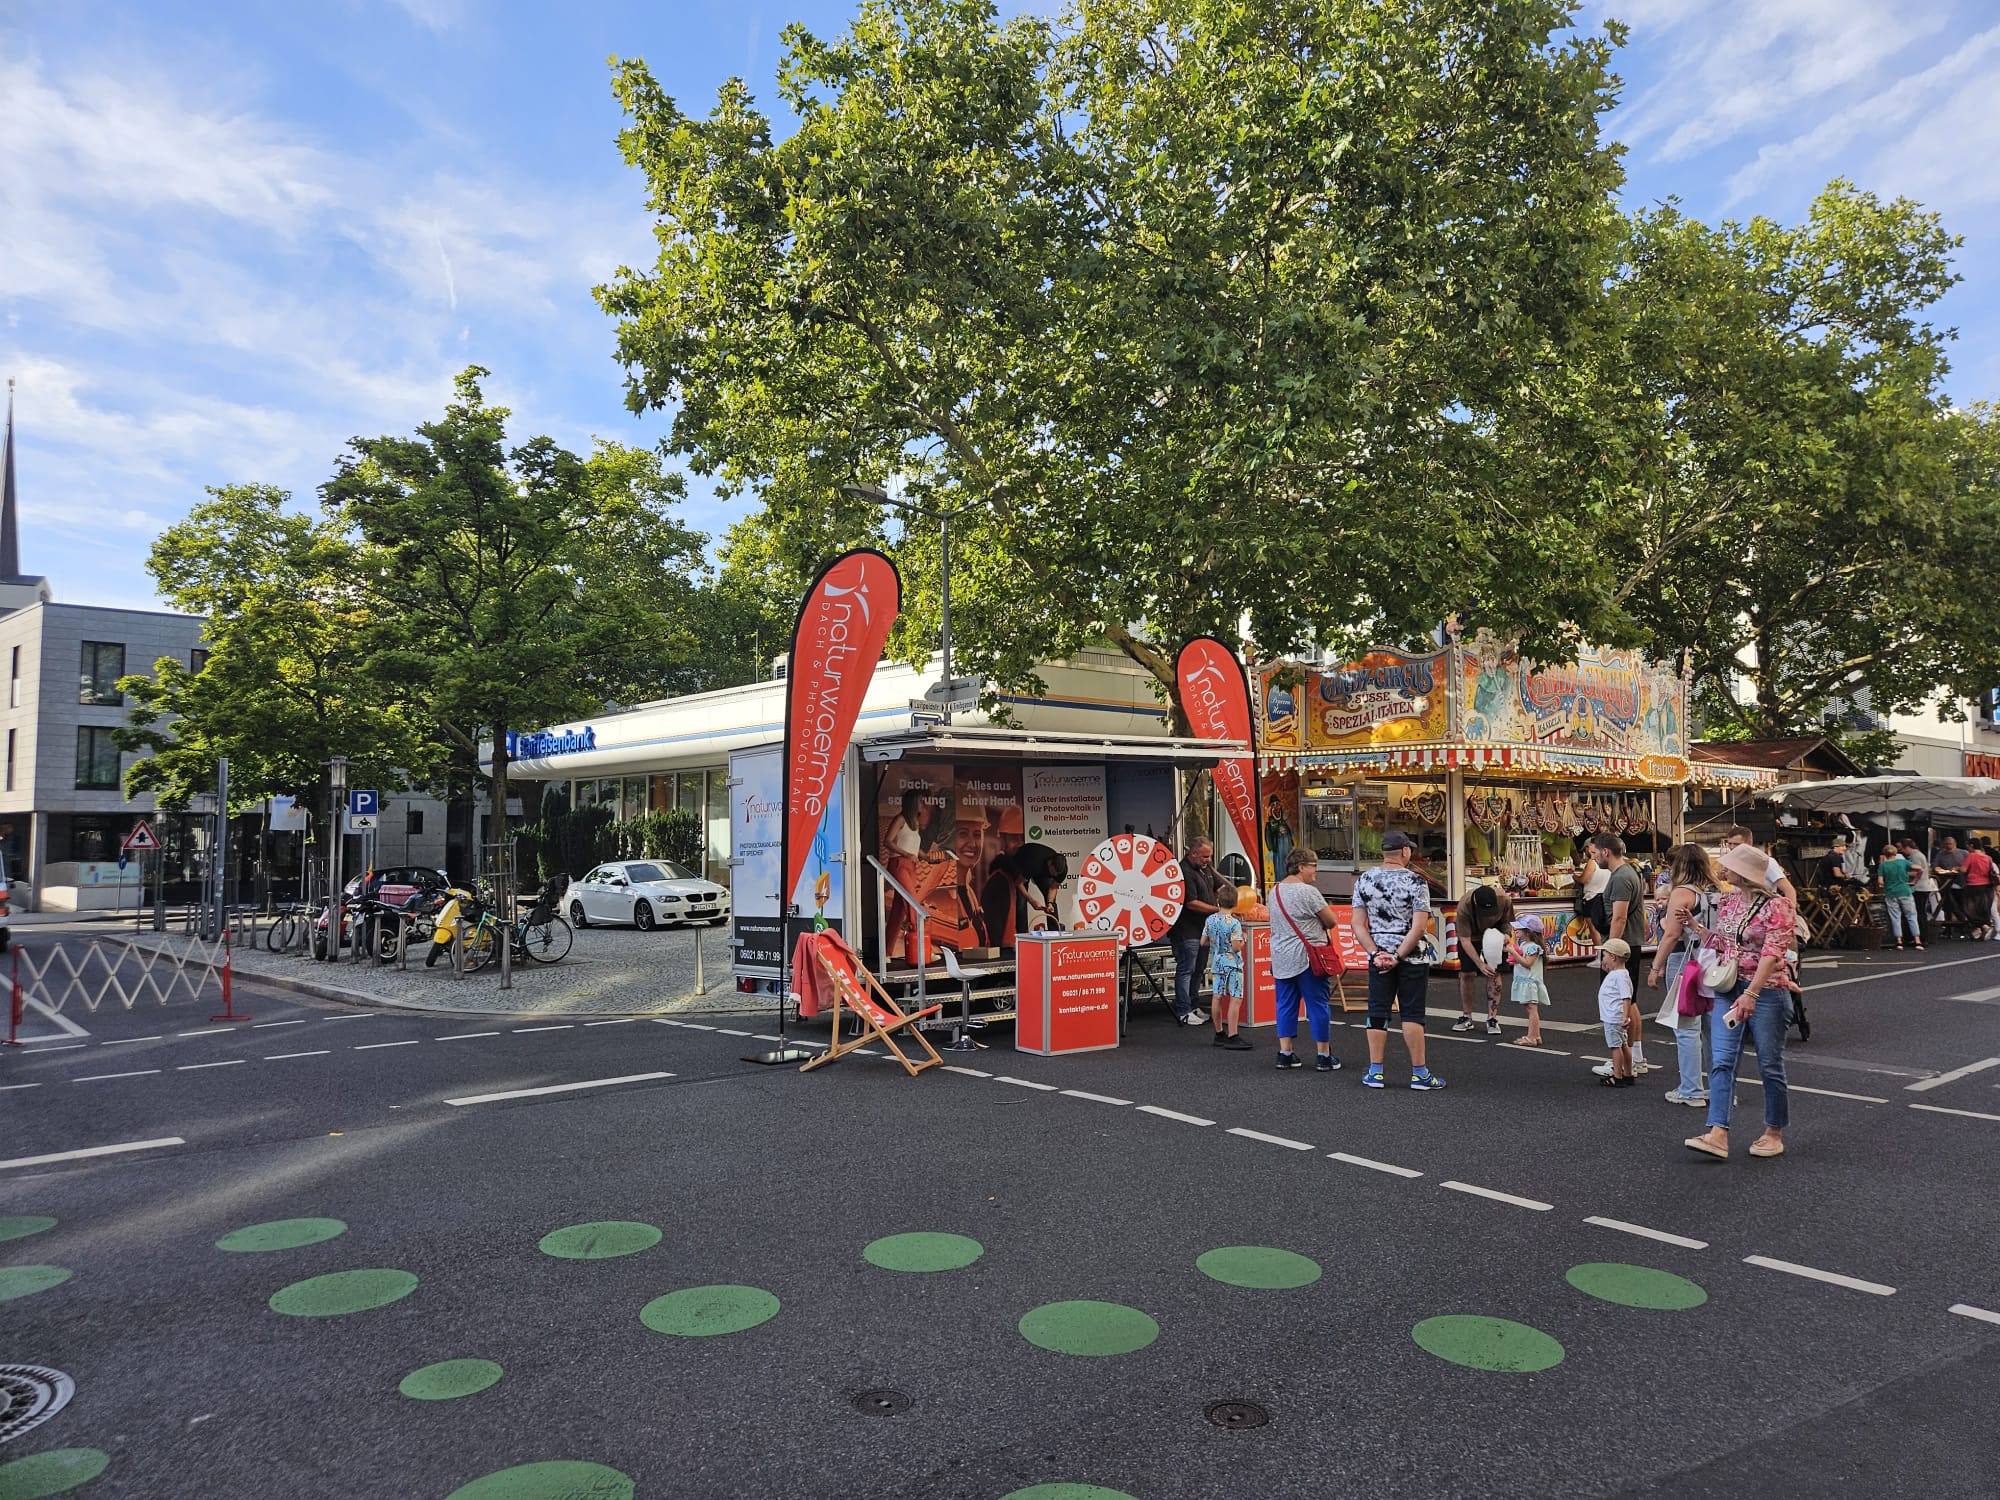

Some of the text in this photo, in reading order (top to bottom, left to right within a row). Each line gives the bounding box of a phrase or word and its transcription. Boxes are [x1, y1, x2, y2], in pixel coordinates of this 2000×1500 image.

[816, 602, 831, 649] DACH
[804, 603, 857, 816] naturwaerme
[1332, 701, 1415, 730] SPEZIALITÄTEN
[789, 680, 819, 815] PHOTOVOLTAIK
[1647, 759, 1677, 778] Traber
[900, 780, 934, 790] Dach-
[967, 780, 1012, 791] Alles aus
[357, 793, 372, 812] P
[962, 794, 1017, 806] einer Hand
[1059, 795, 1104, 803] Installateur
[1031, 805, 1042, 813] für
[1044, 804, 1091, 813] Photovoltaik
[1043, 813, 1089, 822] Rhein-Main
[1044, 828, 1101, 836] Meisterbetrieb
[1062, 948, 1116, 961] naturwaerme
